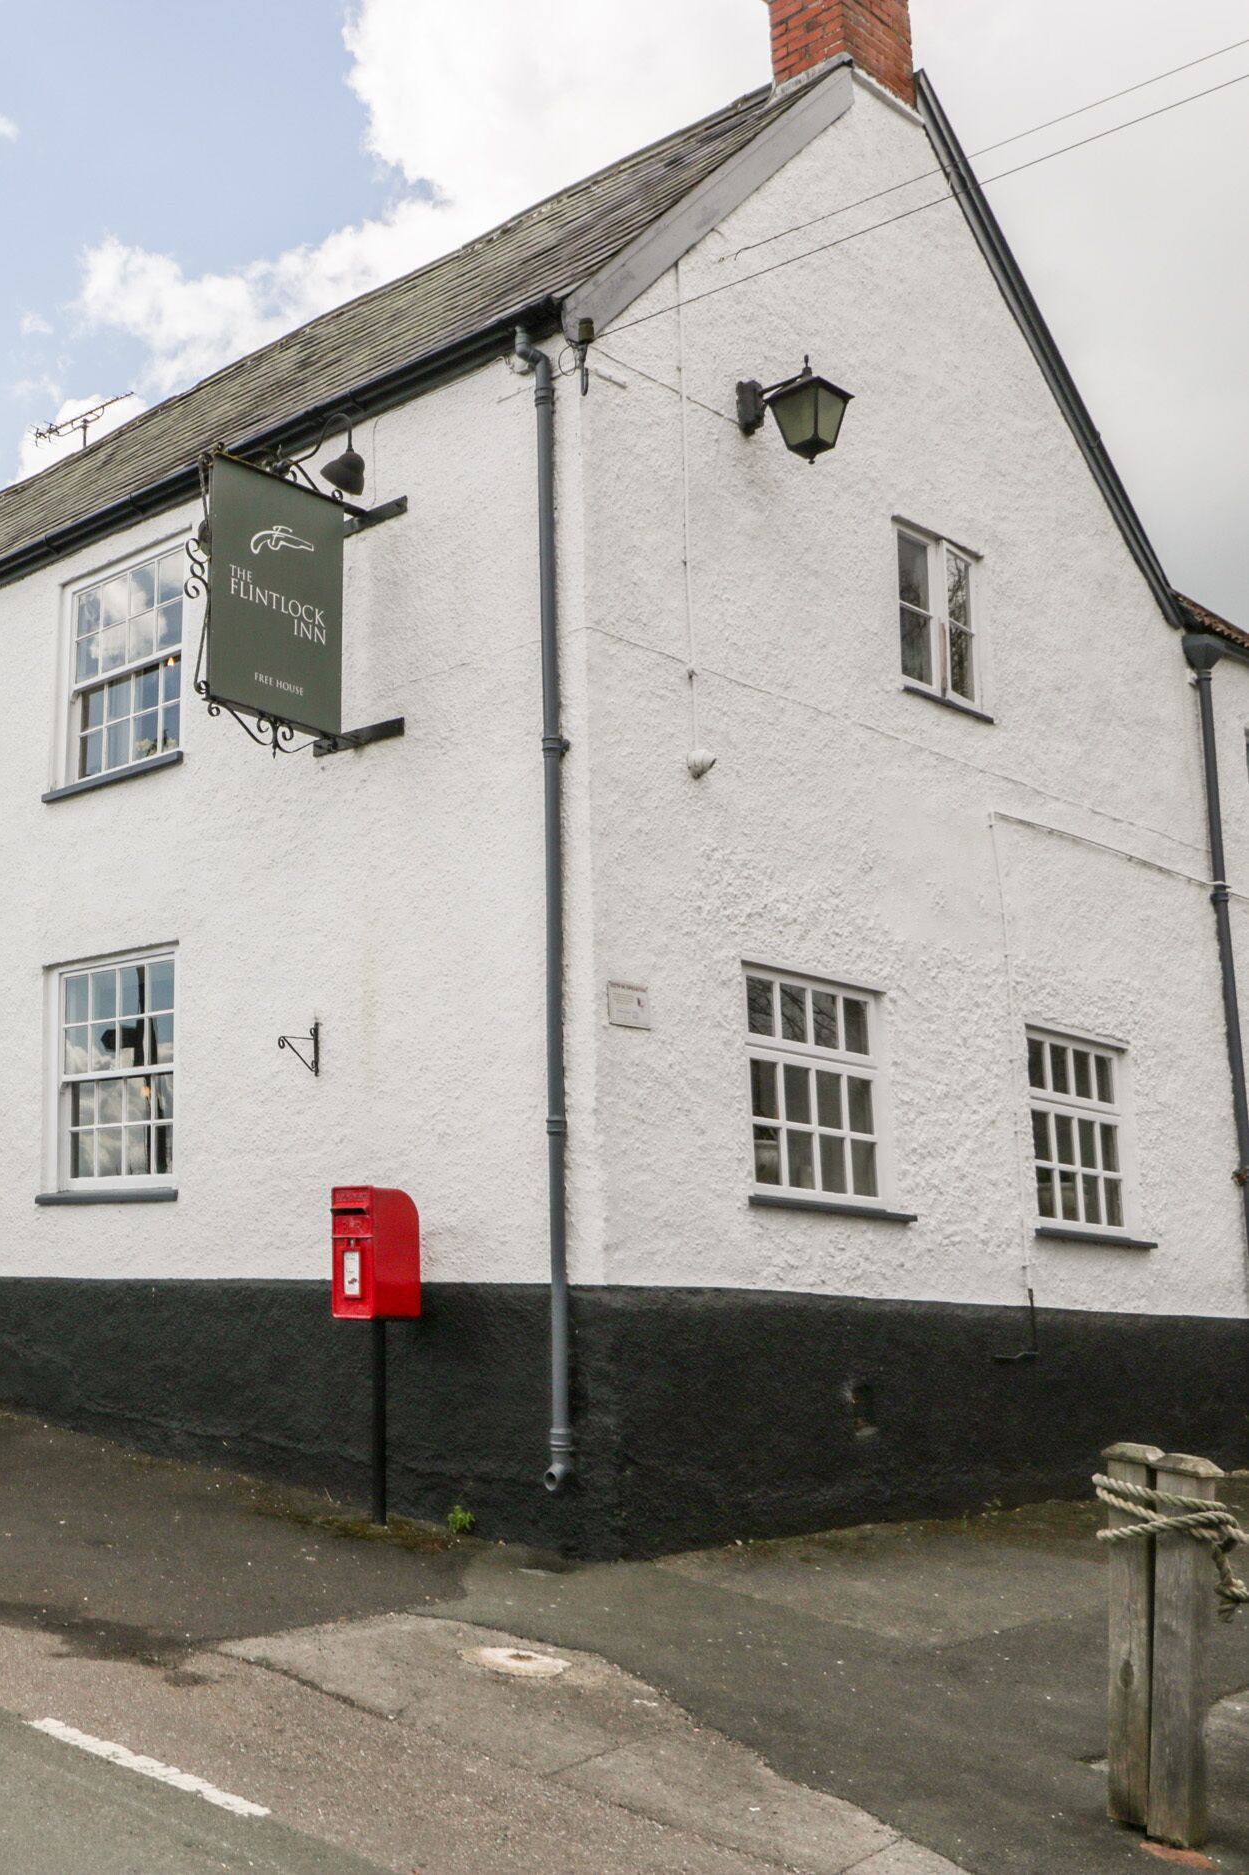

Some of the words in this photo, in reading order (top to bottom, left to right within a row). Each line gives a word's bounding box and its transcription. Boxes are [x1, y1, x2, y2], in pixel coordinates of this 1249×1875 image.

[229, 564, 253, 583] THE
[230, 578, 325, 627] FLINTLOCK
[293, 618, 327, 645] INN
[254, 671, 274, 686] FREE
[275, 679, 304, 696] HOUSE
